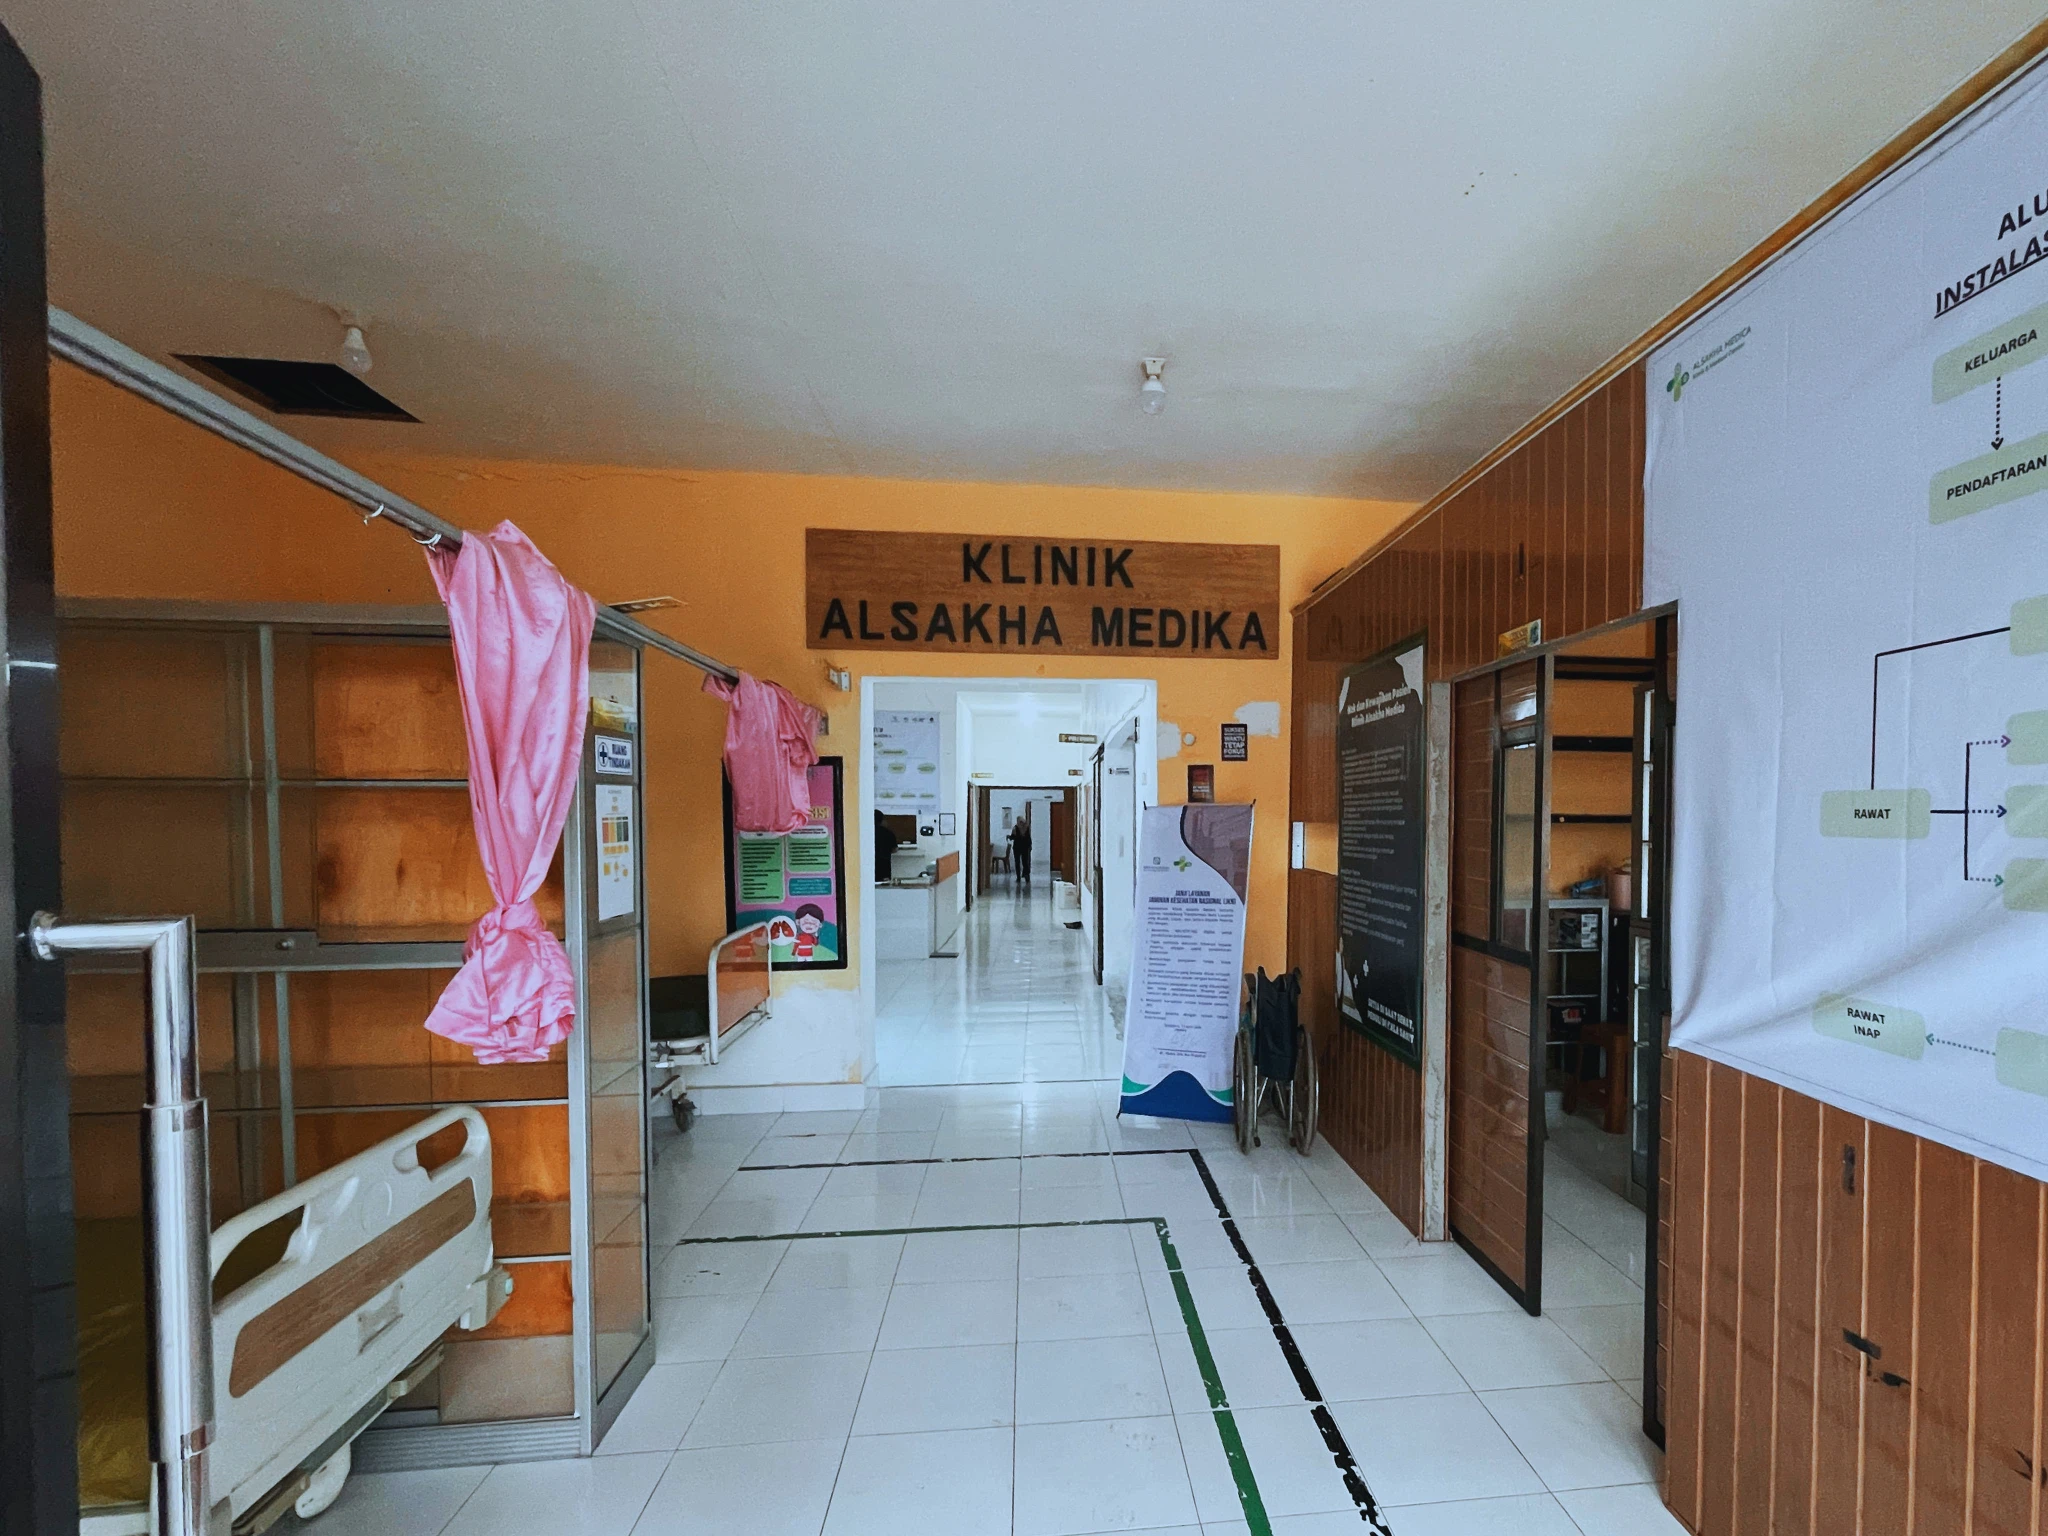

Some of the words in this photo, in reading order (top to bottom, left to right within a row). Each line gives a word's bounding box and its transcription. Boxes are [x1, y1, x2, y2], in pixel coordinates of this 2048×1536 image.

[1693, 345, 1723, 370] ALSAKHA
[1725, 326, 1751, 348] MEDICA
[1964, 329, 2038, 373] KELUARGA
[1946, 454, 2047, 500] PENDAFTARAN
[962, 542, 1135, 589] KLINIK
[819, 597, 1064, 648] ALSAKHA
[1091, 606, 1268, 652] MEDIKA
[1853, 808, 1892, 820] RAWAT
[1846, 1006, 1886, 1025] RAWAT
[1853, 1024, 1881, 1041] INAP
